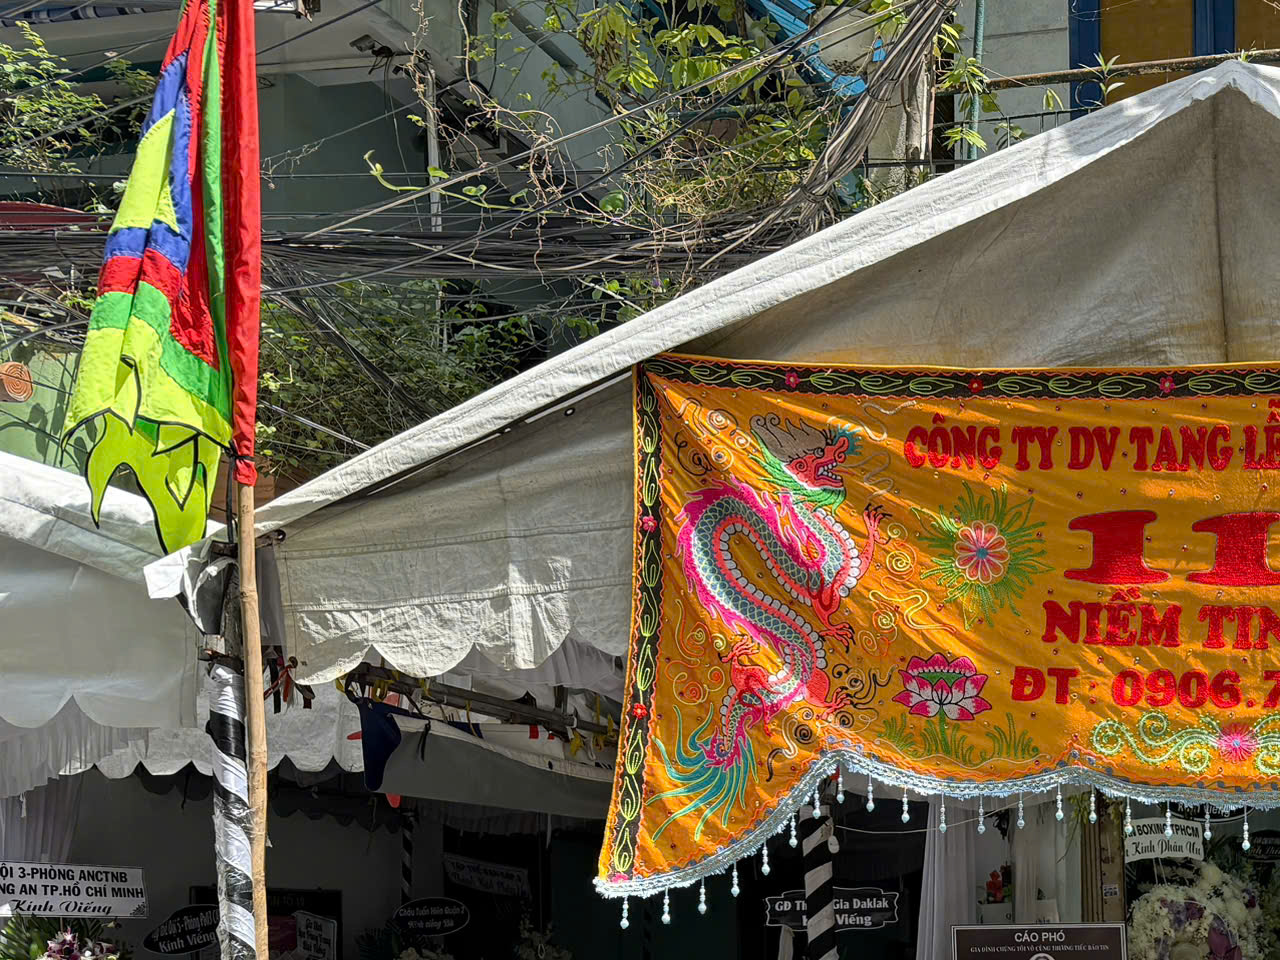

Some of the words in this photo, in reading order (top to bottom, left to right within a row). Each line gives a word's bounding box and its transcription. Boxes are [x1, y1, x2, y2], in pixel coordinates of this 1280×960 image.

[904, 413, 1002, 471] CÔNG
[1010, 425, 1061, 471] TY
[1066, 424, 1122, 472] DV
[1129, 425, 1235, 472] TANG
[1042, 587, 1181, 650] NIỀM
[18, 865, 75, 882] 3-PHÒNG
[78, 869, 128, 883] ANCTNB
[19, 884, 38, 896] AN
[41, 881, 81, 897] TP.HỒ
[85, 884, 107, 898] CHÍ
[111, 887, 144, 899] MINH
[10, 899, 55, 913] Kính
[59, 900, 112, 915] Viếng
[775, 900, 792, 912] GĐ
[833, 898, 850, 910] Gia
[852, 897, 889, 910] Daklak
[835, 912, 873, 927] Viếng
[159, 937, 185, 953] Kính
[187, 931, 218, 946] Viếng
[1014, 930, 1039, 942] CÁO
[1042, 929, 1065, 942] PHÓ
